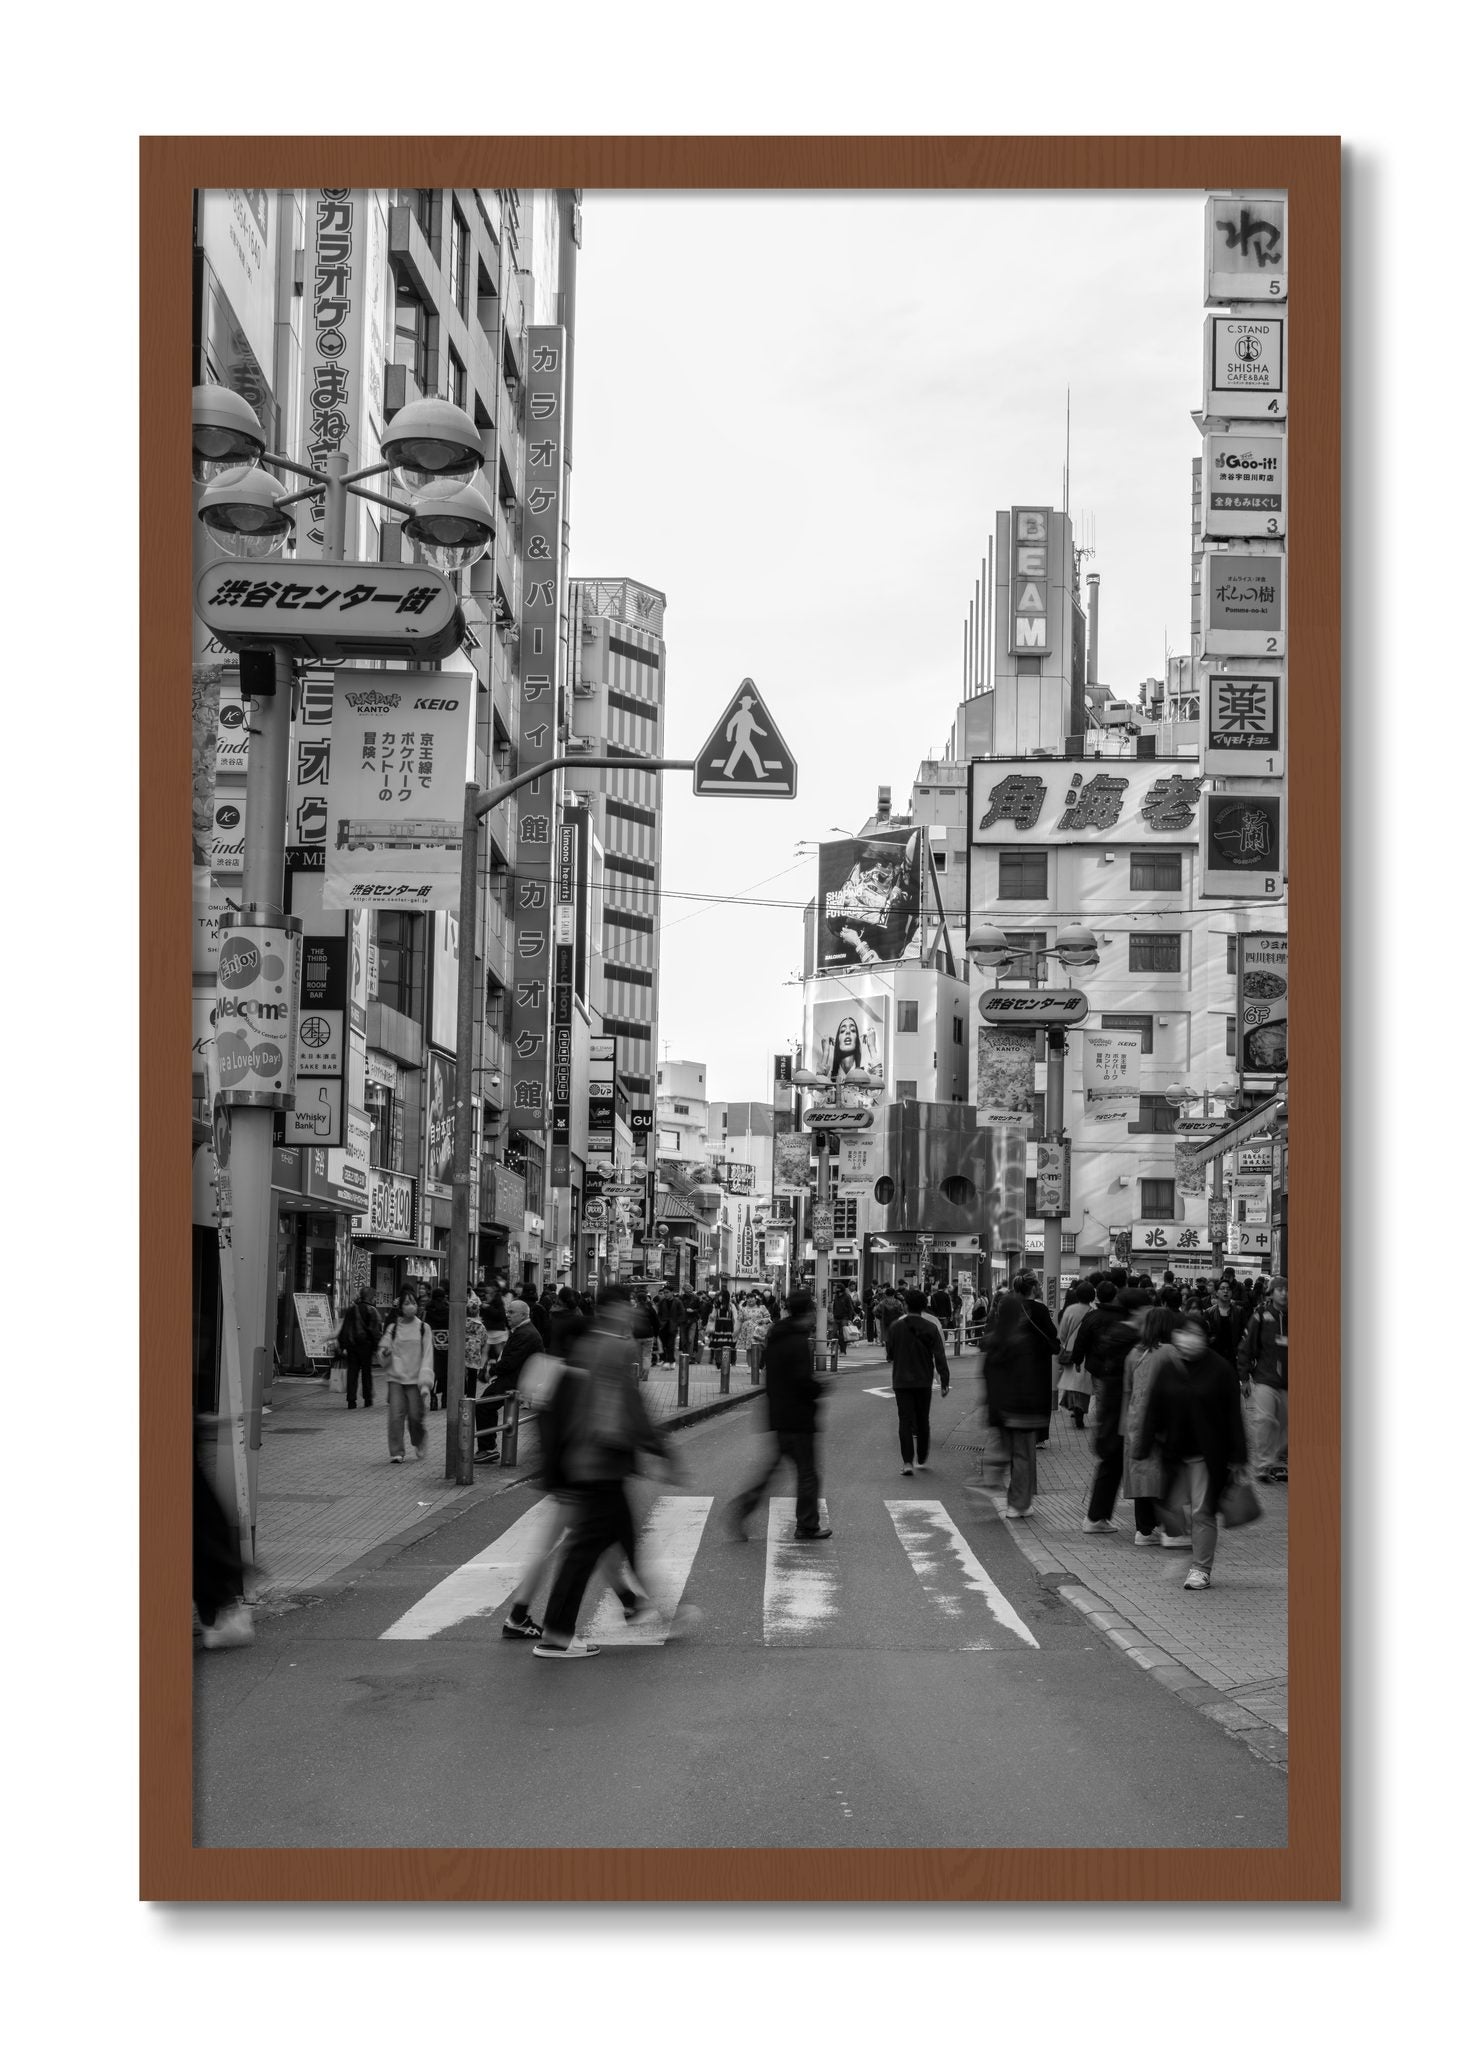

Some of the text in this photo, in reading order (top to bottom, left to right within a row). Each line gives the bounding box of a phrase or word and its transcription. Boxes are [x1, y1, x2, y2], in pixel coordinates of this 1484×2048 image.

[314, 201, 353, 331] カラオケ
[1269, 280, 1281, 295] 5
[1227, 324, 1270, 334] C.STAND
[1227, 363, 1270, 373] SHISHA
[1227, 373, 1269, 381] CAFE&BAR
[1268, 398, 1280, 414] 4
[1226, 454, 1277, 469] Goo-it!
[1219, 472, 1274, 482] 渋谷宇田川町店
[1214, 496, 1278, 508] 全身もみほぐし
[1267, 518, 1278, 534] 3
[1016, 511, 1047, 647] BEAM
[208, 579, 442, 615] 渋谷センター街
[1266, 637, 1277, 652] 2
[414, 698, 459, 711] KEIO
[1219, 682, 1266, 731] 薬
[1213, 733, 1271, 747] マツモトキヨシ
[361, 731, 377, 771] 冒険へ
[379, 731, 396, 801] カントーの
[418, 732, 434, 788] 京王線で
[1266, 757, 1274, 772] 1
[980, 772, 1204, 830] 角海老
[1213, 810, 1271, 855] 一蘭
[562, 829, 571, 863] kimono
[350, 884, 433, 896] 渋谷センター街
[1265, 878, 1275, 893] B
[310, 948, 324, 956] THE
[220, 949, 258, 983] Enjoy
[306, 981, 327, 989] ROOM
[217, 996, 288, 1020] Welcome
[986, 998, 1083, 1010] 渋谷センター街
[1244, 1006, 1270, 1025] 6F
[233, 1051, 261, 1069] Lovely
[262, 1052, 281, 1065] Day!
[295, 1111, 326, 1124] Whisky
[633, 1116, 652, 1126] GU
[807, 1112, 865, 1122] 渋谷センター街
[295, 1121, 314, 1130] Bank
[1145, 1227, 1200, 1248] 兆楽
